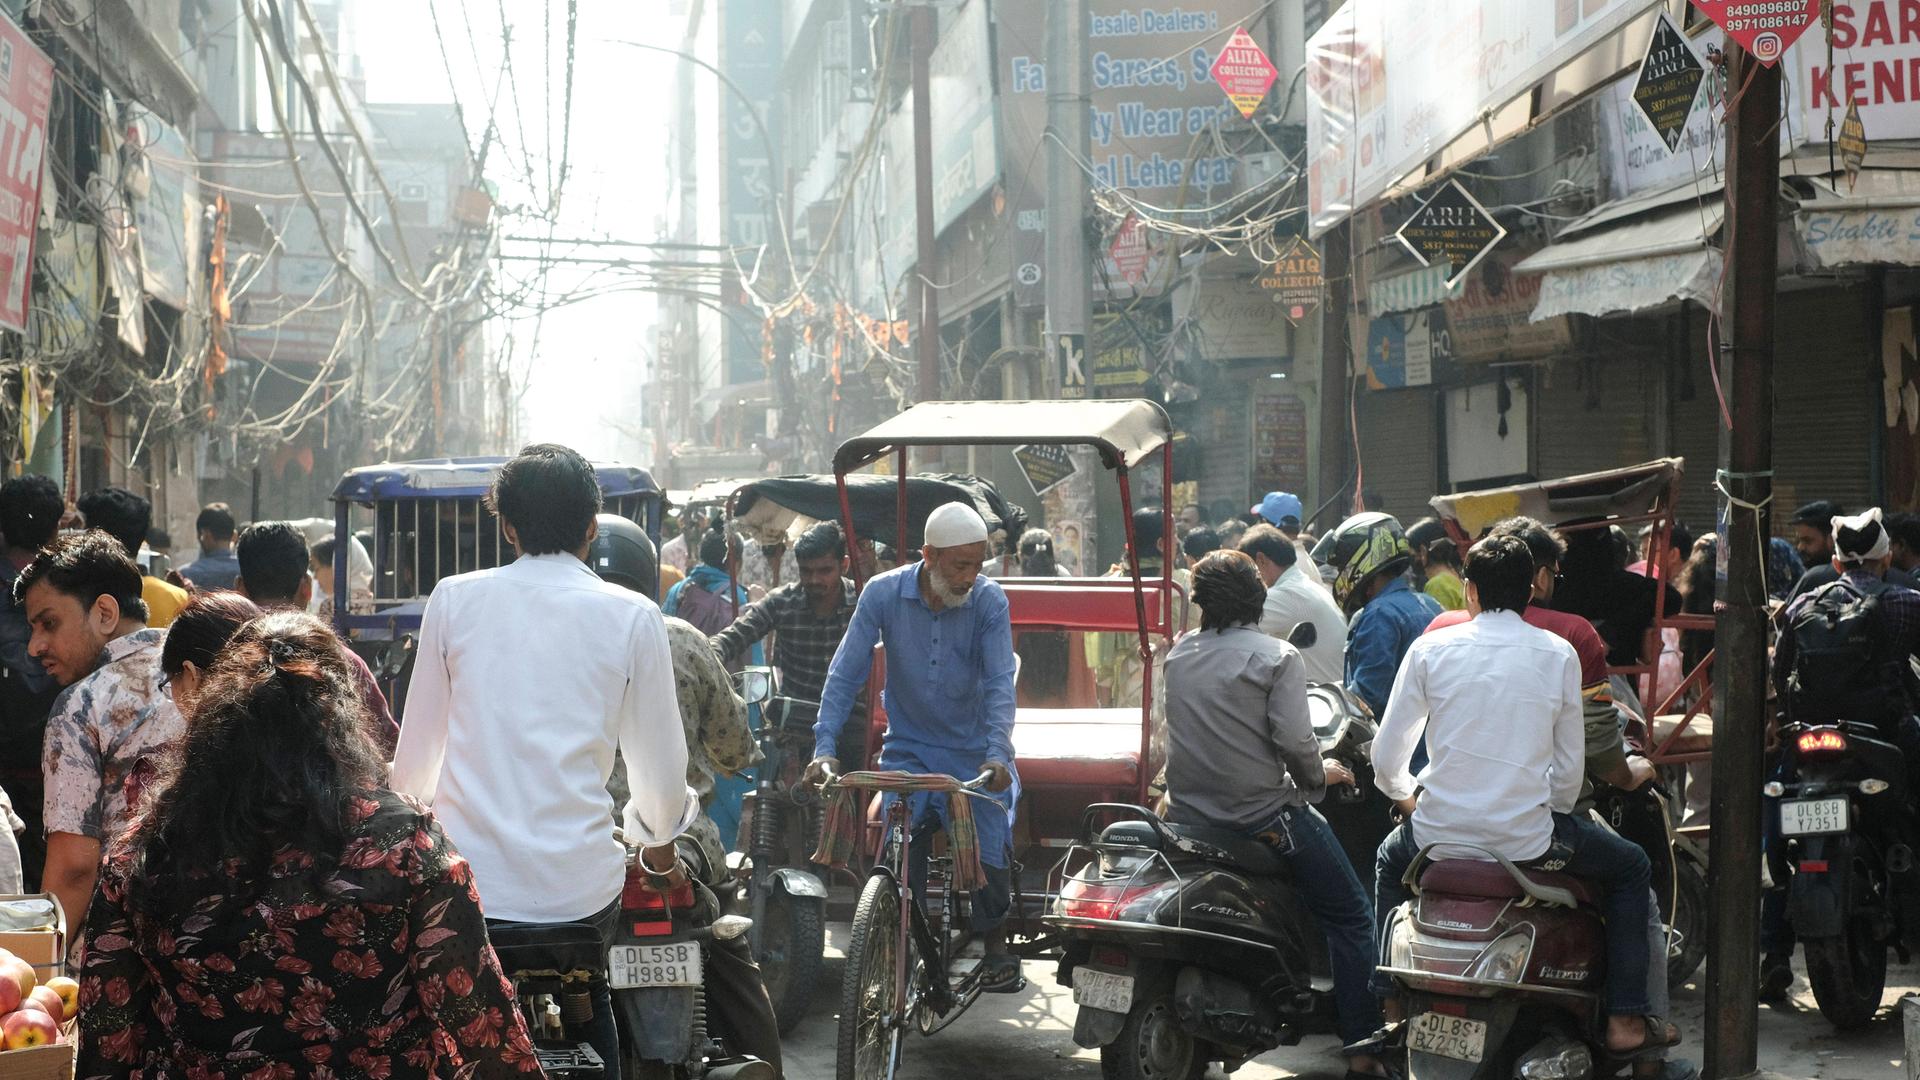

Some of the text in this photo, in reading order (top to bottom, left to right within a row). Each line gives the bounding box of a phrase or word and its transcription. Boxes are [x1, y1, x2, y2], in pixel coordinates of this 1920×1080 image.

[1726, 0, 1808, 17] 8490896807
[1726, 14, 1808, 31] 9971086147
[1226, 48, 1261, 65] ALIYA
[1219, 65, 1271, 77] COLLECTION
[1118, 102, 1181, 137] Wear
[1807, 214, 1898, 244] Shakti
[1274, 258, 1320, 275] FAIQ
[1261, 275, 1322, 289] COLLECTI
[1797, 801, 1840, 817] DL8SB
[1798, 816, 1839, 831] Y7351
[1109, 834, 1140, 842] HONDA
[1437, 920, 1473, 930] SUZUKI
[626, 945, 688, 965] DL5SB
[627, 965, 688, 984] H9891
